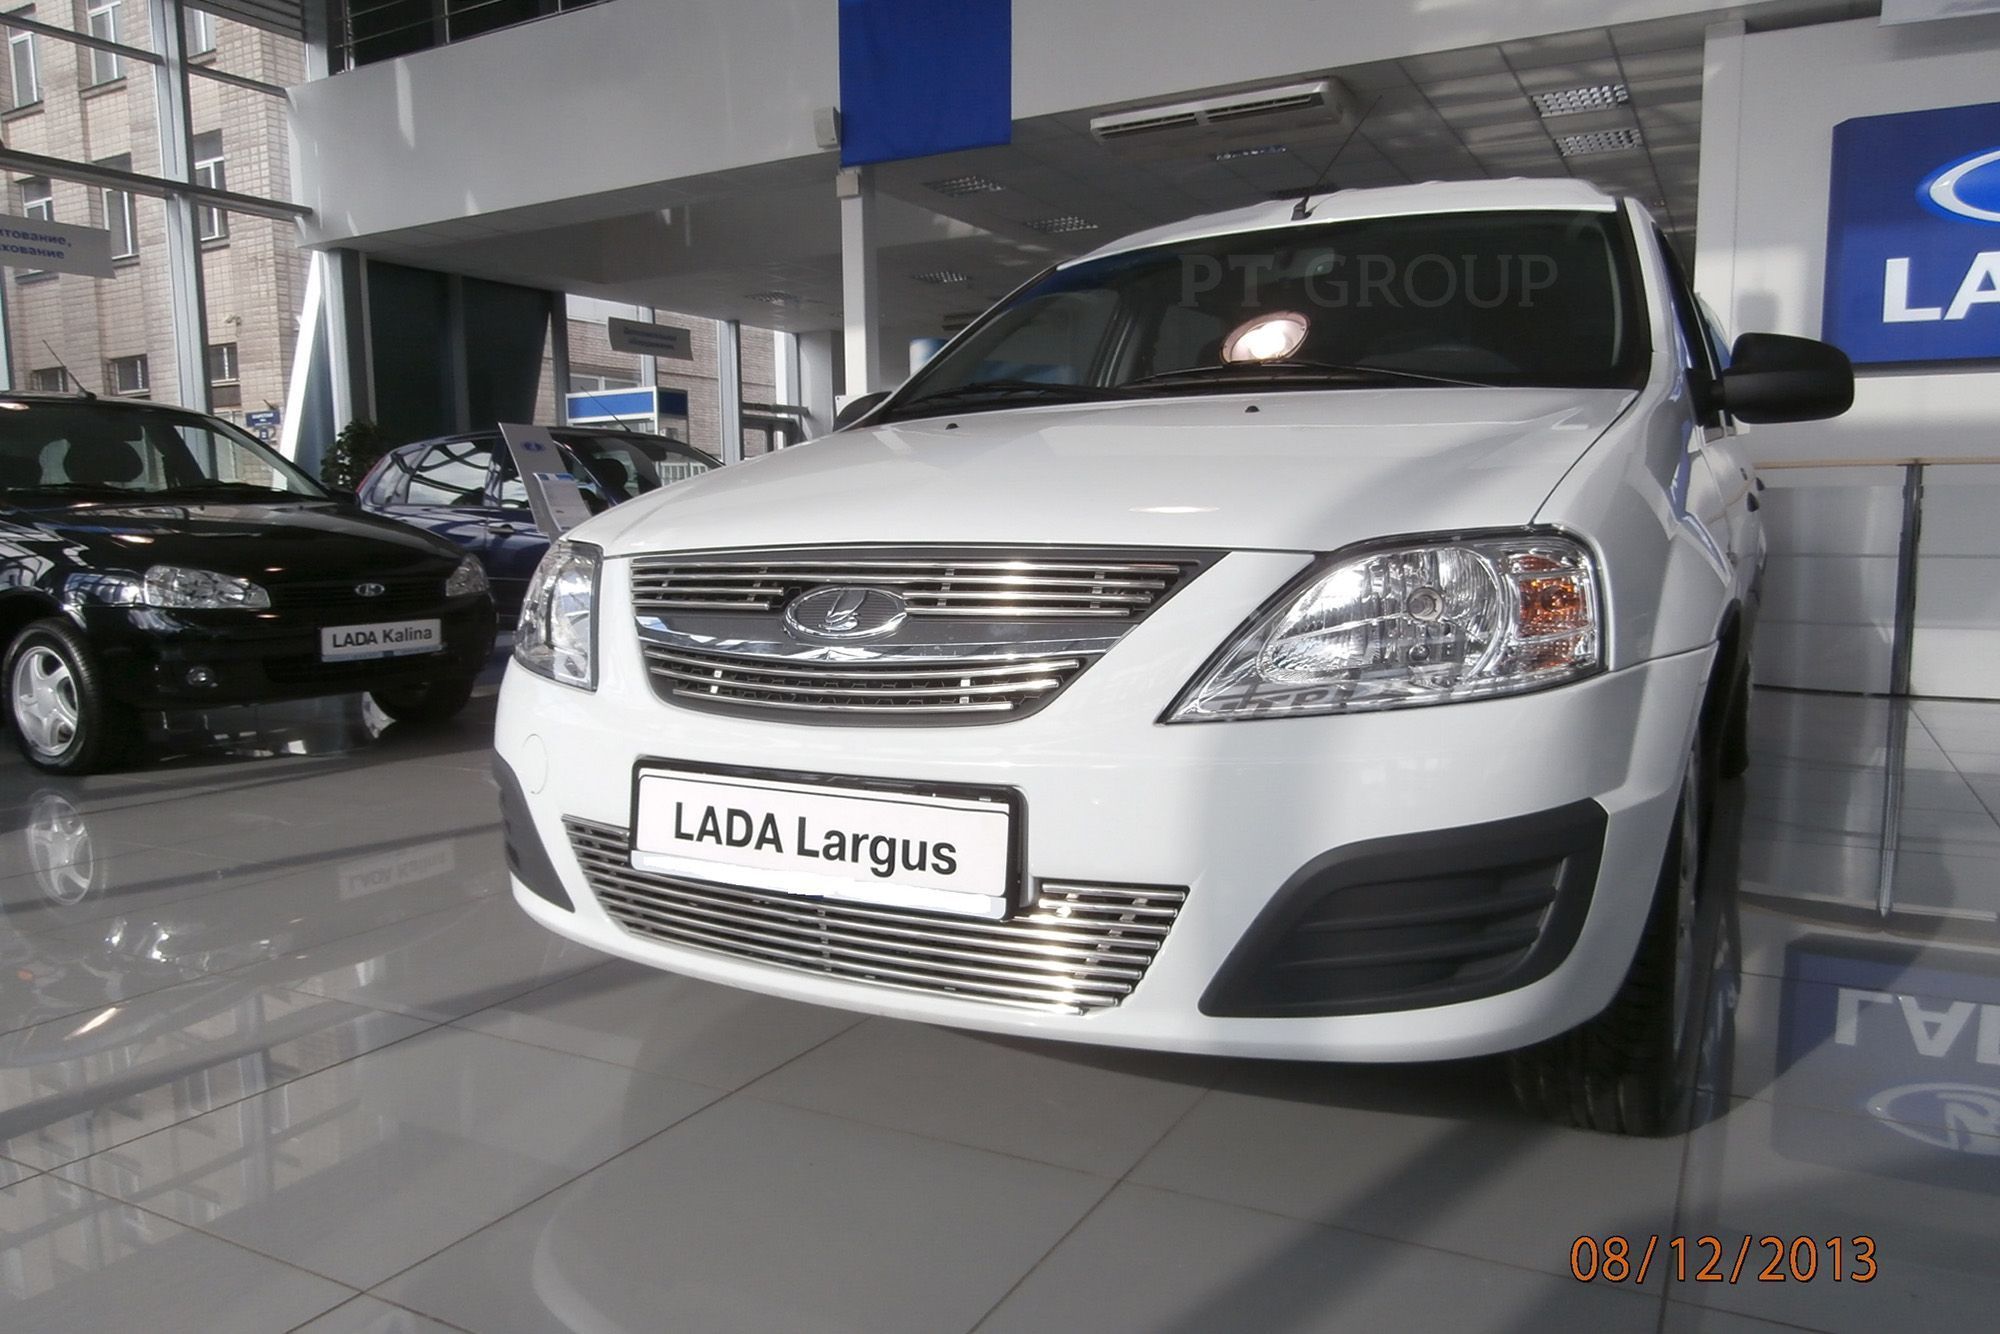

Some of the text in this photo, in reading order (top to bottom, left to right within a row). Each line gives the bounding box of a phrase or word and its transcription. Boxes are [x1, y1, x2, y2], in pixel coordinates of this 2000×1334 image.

[0, 243, 65, 259] хование
[332, 627, 433, 649] LADA Kalina
[674, 801, 958, 878] LADA Largus
